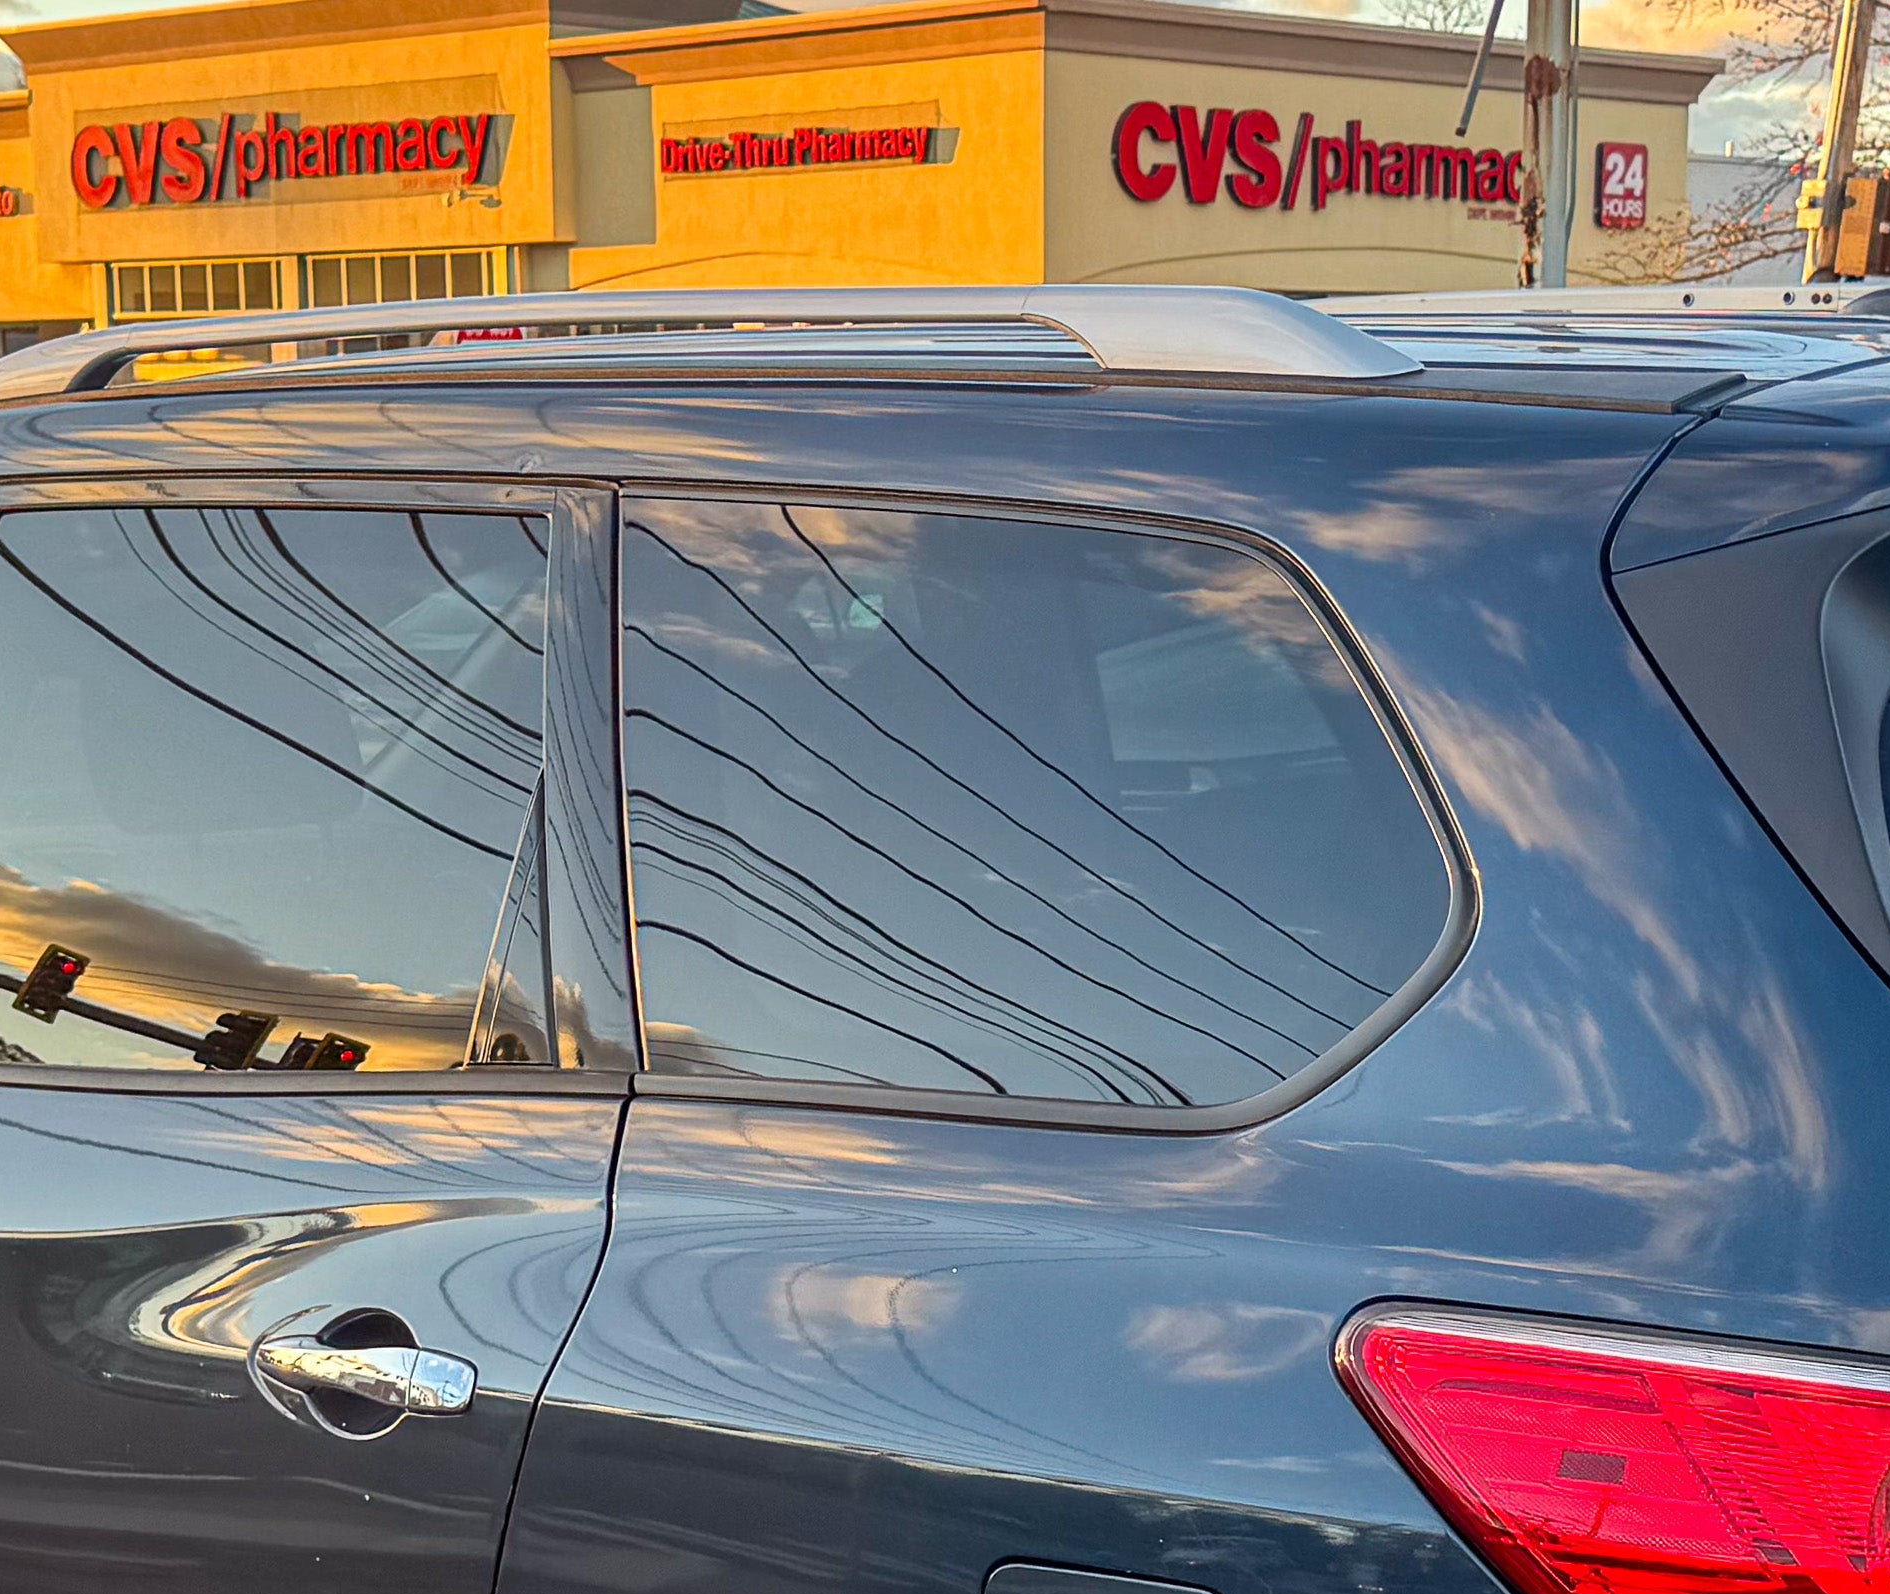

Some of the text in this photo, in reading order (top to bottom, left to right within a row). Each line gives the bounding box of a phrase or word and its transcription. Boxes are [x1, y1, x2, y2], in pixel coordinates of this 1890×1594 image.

[71, 112, 488, 208] CVS/pharmacy
[661, 127, 928, 172] Drive-Thru Pharmacy
[1113, 101, 1522, 211] CVS/pharmac
[1604, 153, 1644, 197] 24
[1603, 200, 1643, 218] HOURS
